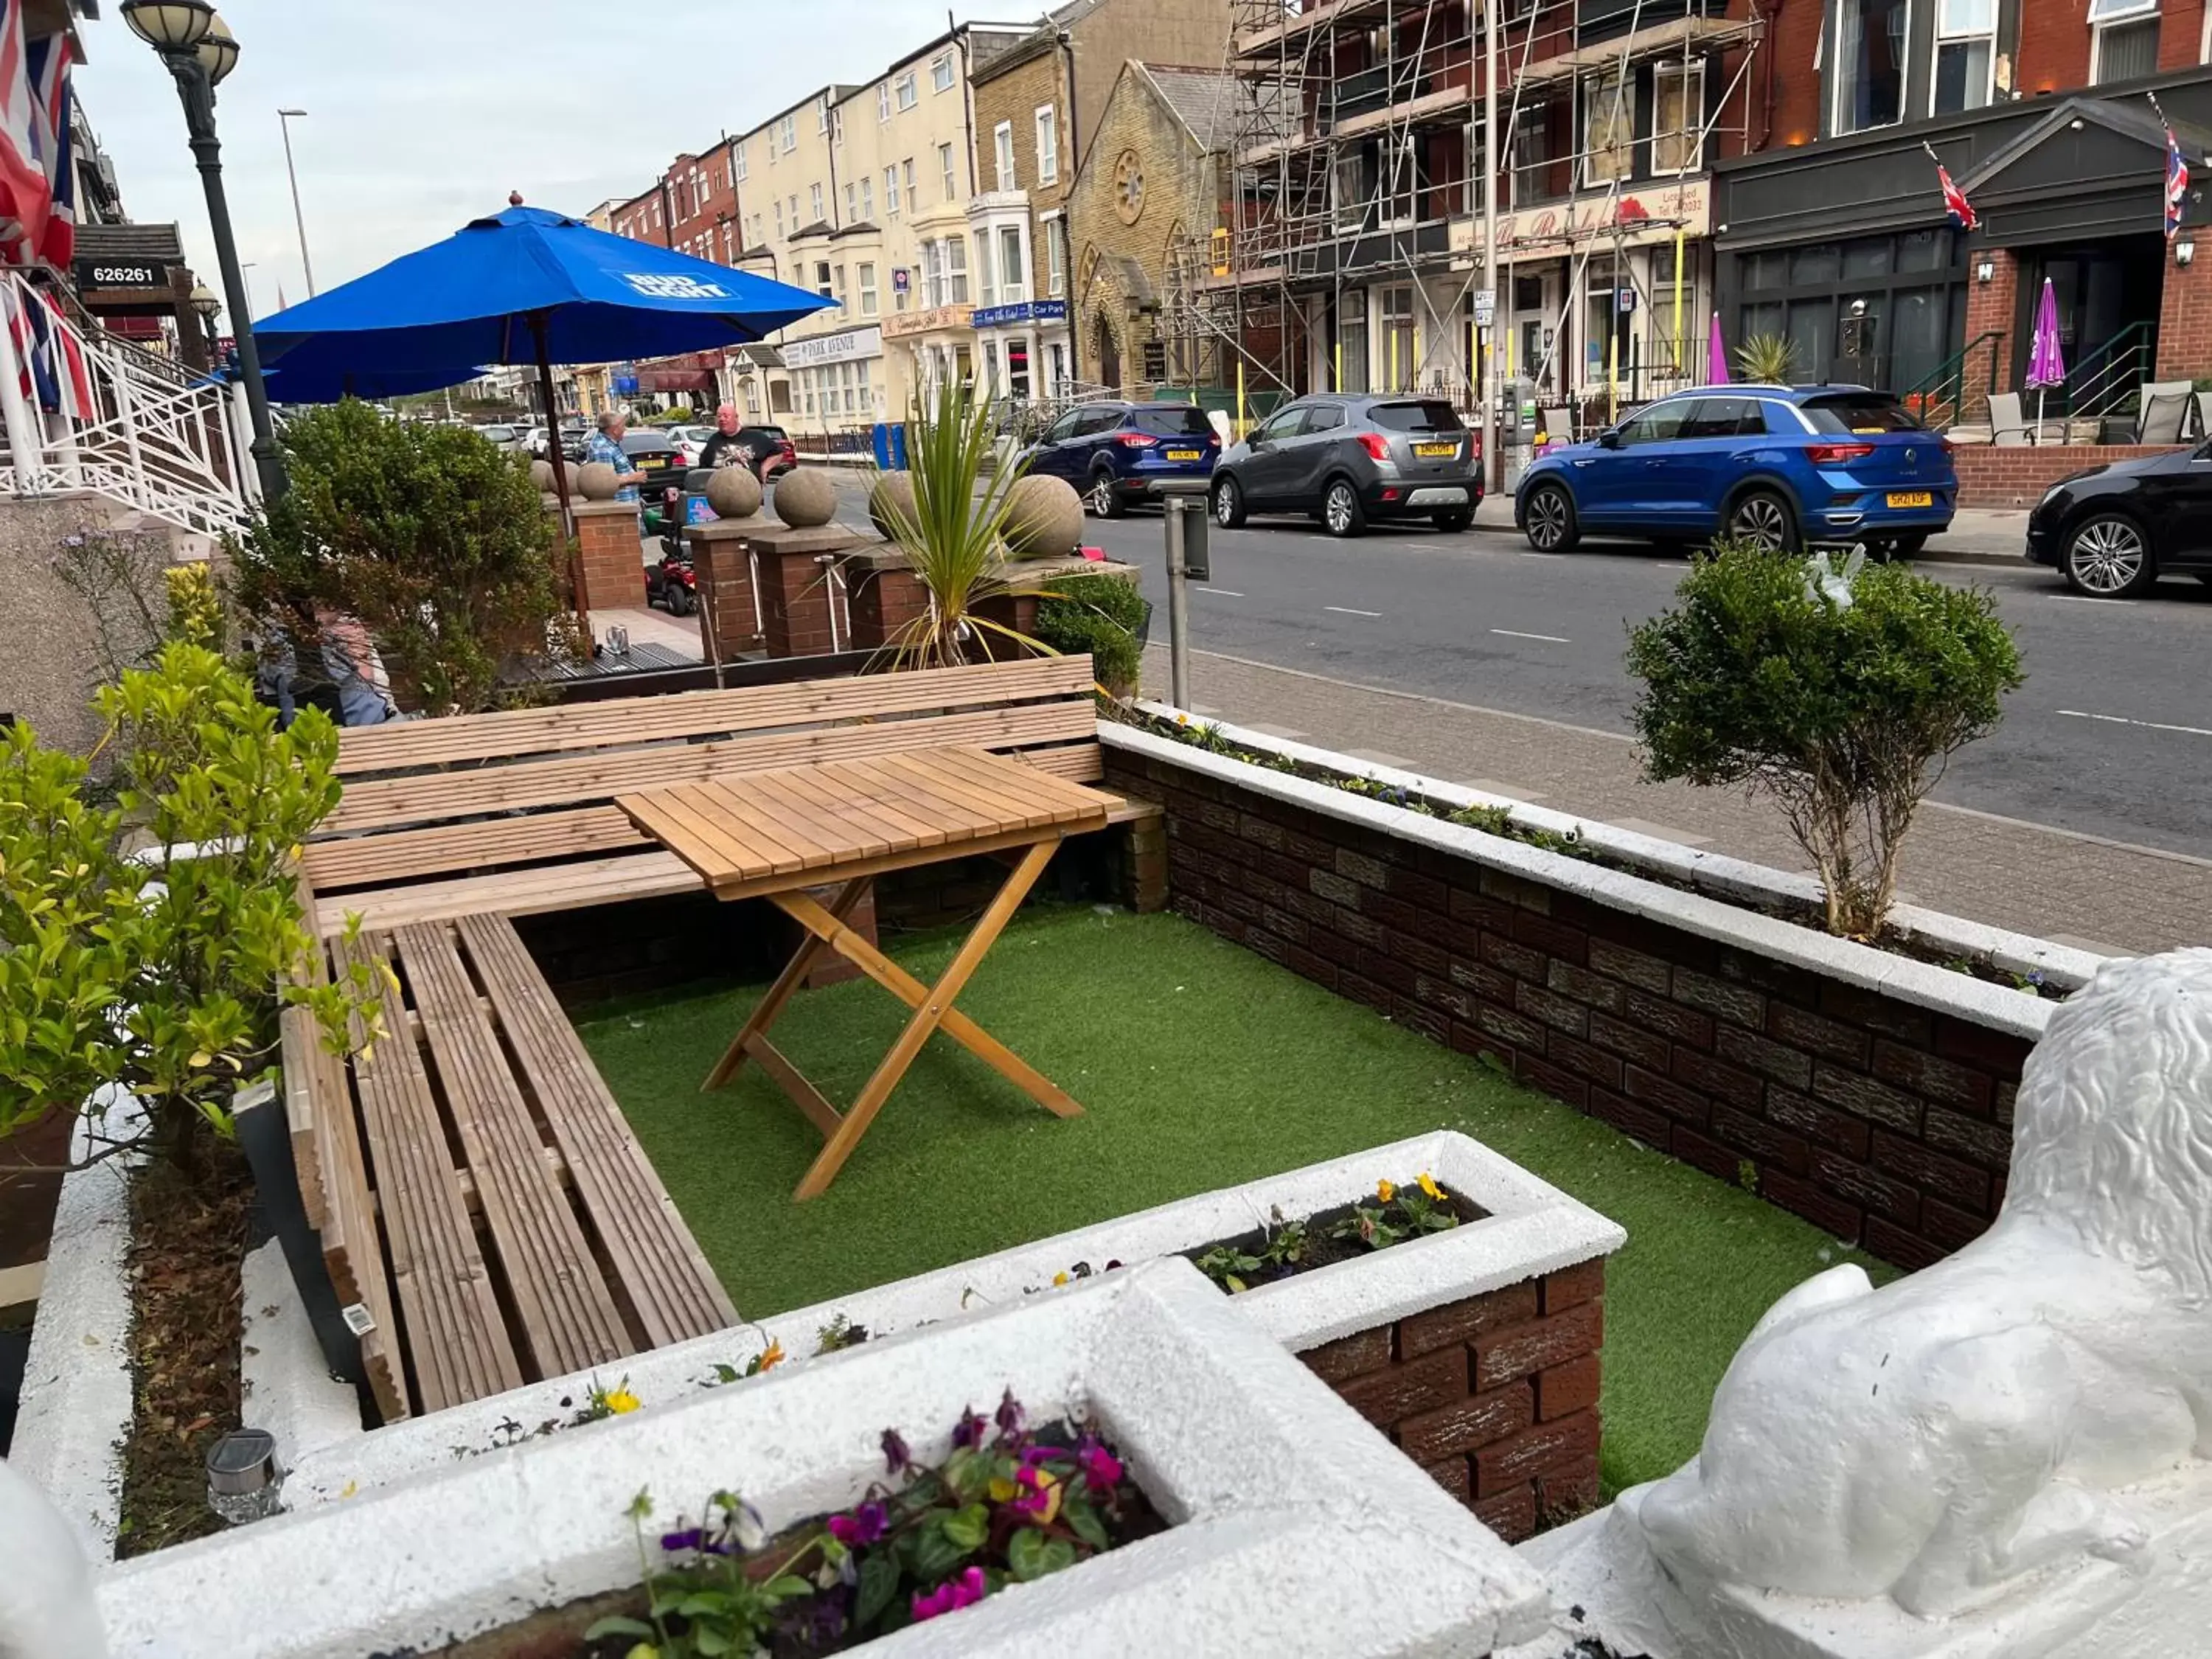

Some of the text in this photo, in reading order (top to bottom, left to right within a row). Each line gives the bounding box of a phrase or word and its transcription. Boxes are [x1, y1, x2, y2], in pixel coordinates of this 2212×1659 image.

[94, 268, 153, 282] 626261
[622, 273, 697, 286] BUD
[629, 283, 732, 298] LIGHT
[1048, 305, 1064, 313] Park
[807, 340, 826, 356] PARK
[828, 335, 855, 353] AVENUE
